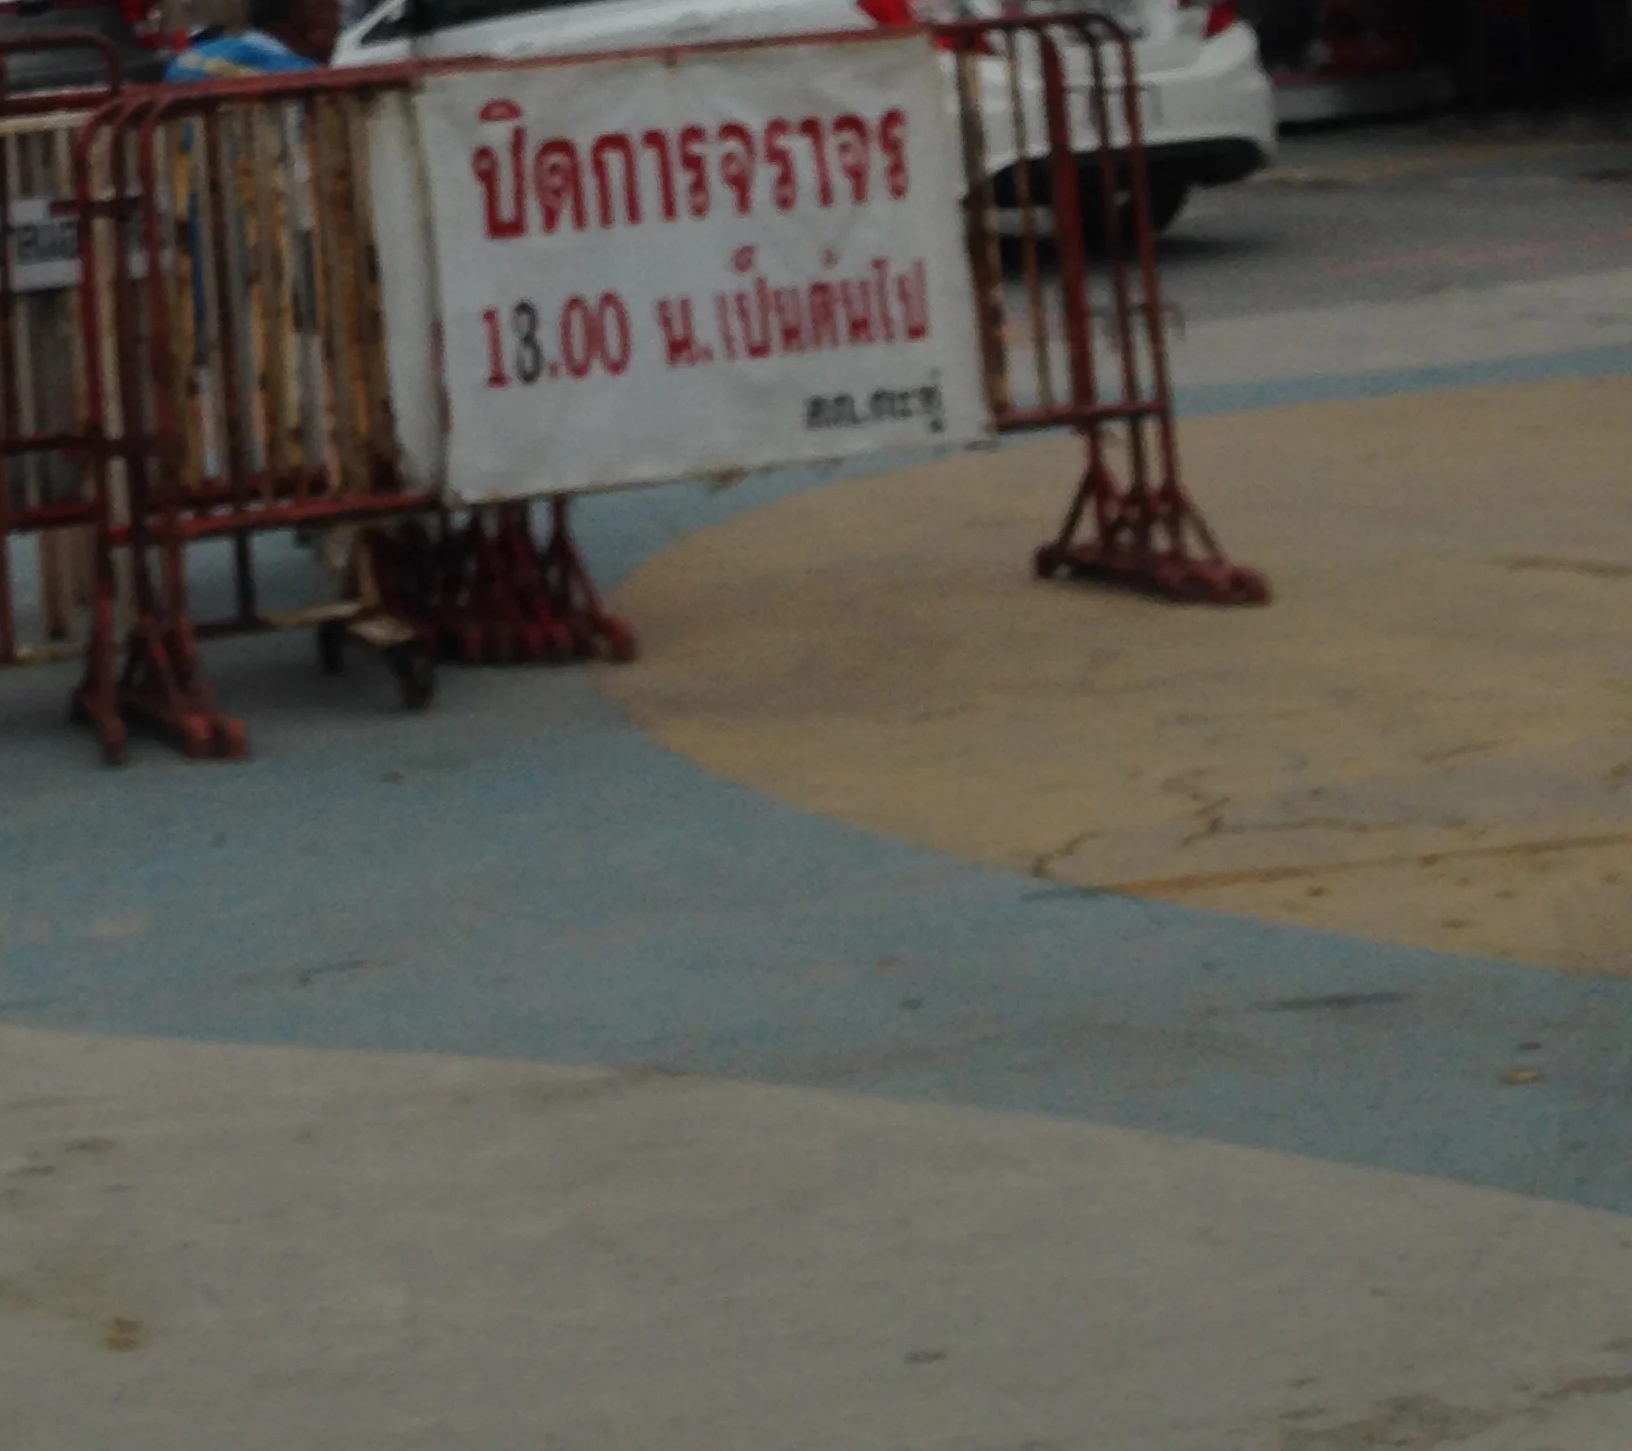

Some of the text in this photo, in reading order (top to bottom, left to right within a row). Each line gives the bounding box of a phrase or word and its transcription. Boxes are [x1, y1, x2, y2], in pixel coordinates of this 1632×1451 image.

[472, 98, 911, 241] ปิดการจราจร
